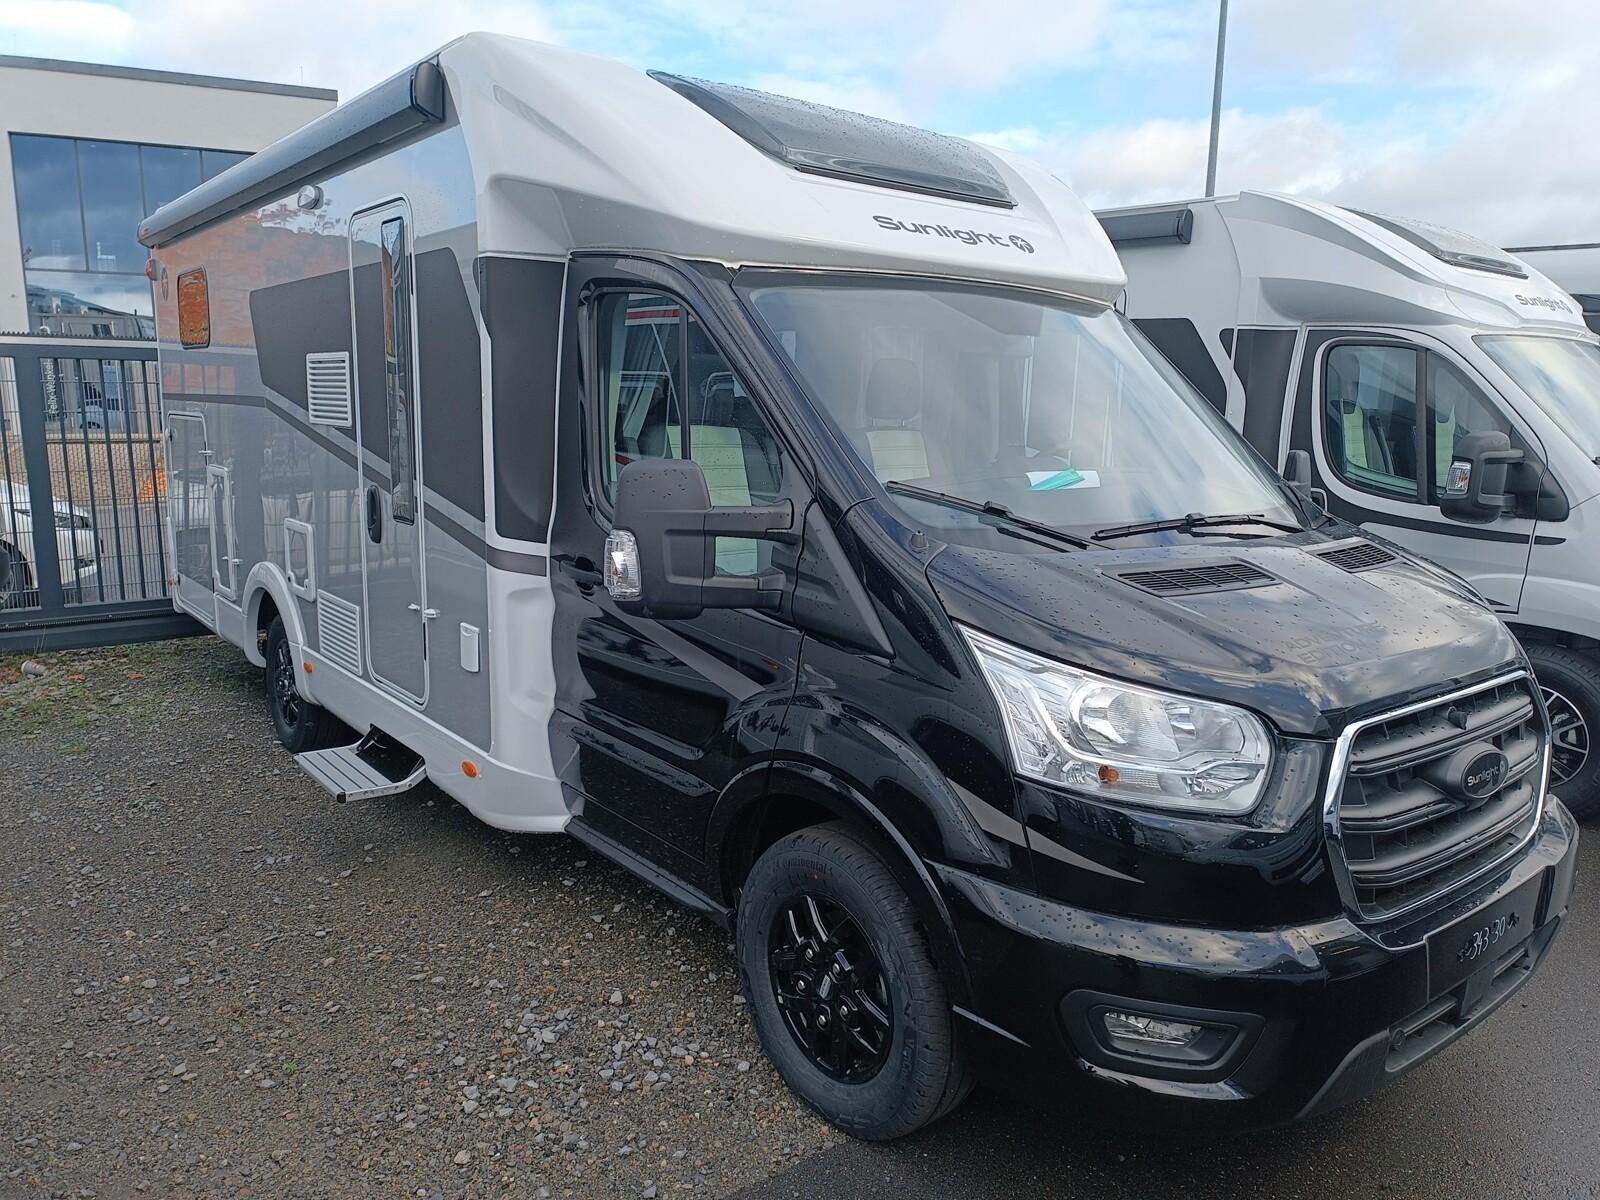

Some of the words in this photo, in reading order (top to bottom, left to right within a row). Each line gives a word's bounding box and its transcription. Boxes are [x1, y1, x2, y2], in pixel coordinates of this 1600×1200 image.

[872, 215, 1010, 246] Sunlight
[1514, 294, 1564, 311] Sunlight
[1467, 765, 1499, 786] Sunlight
